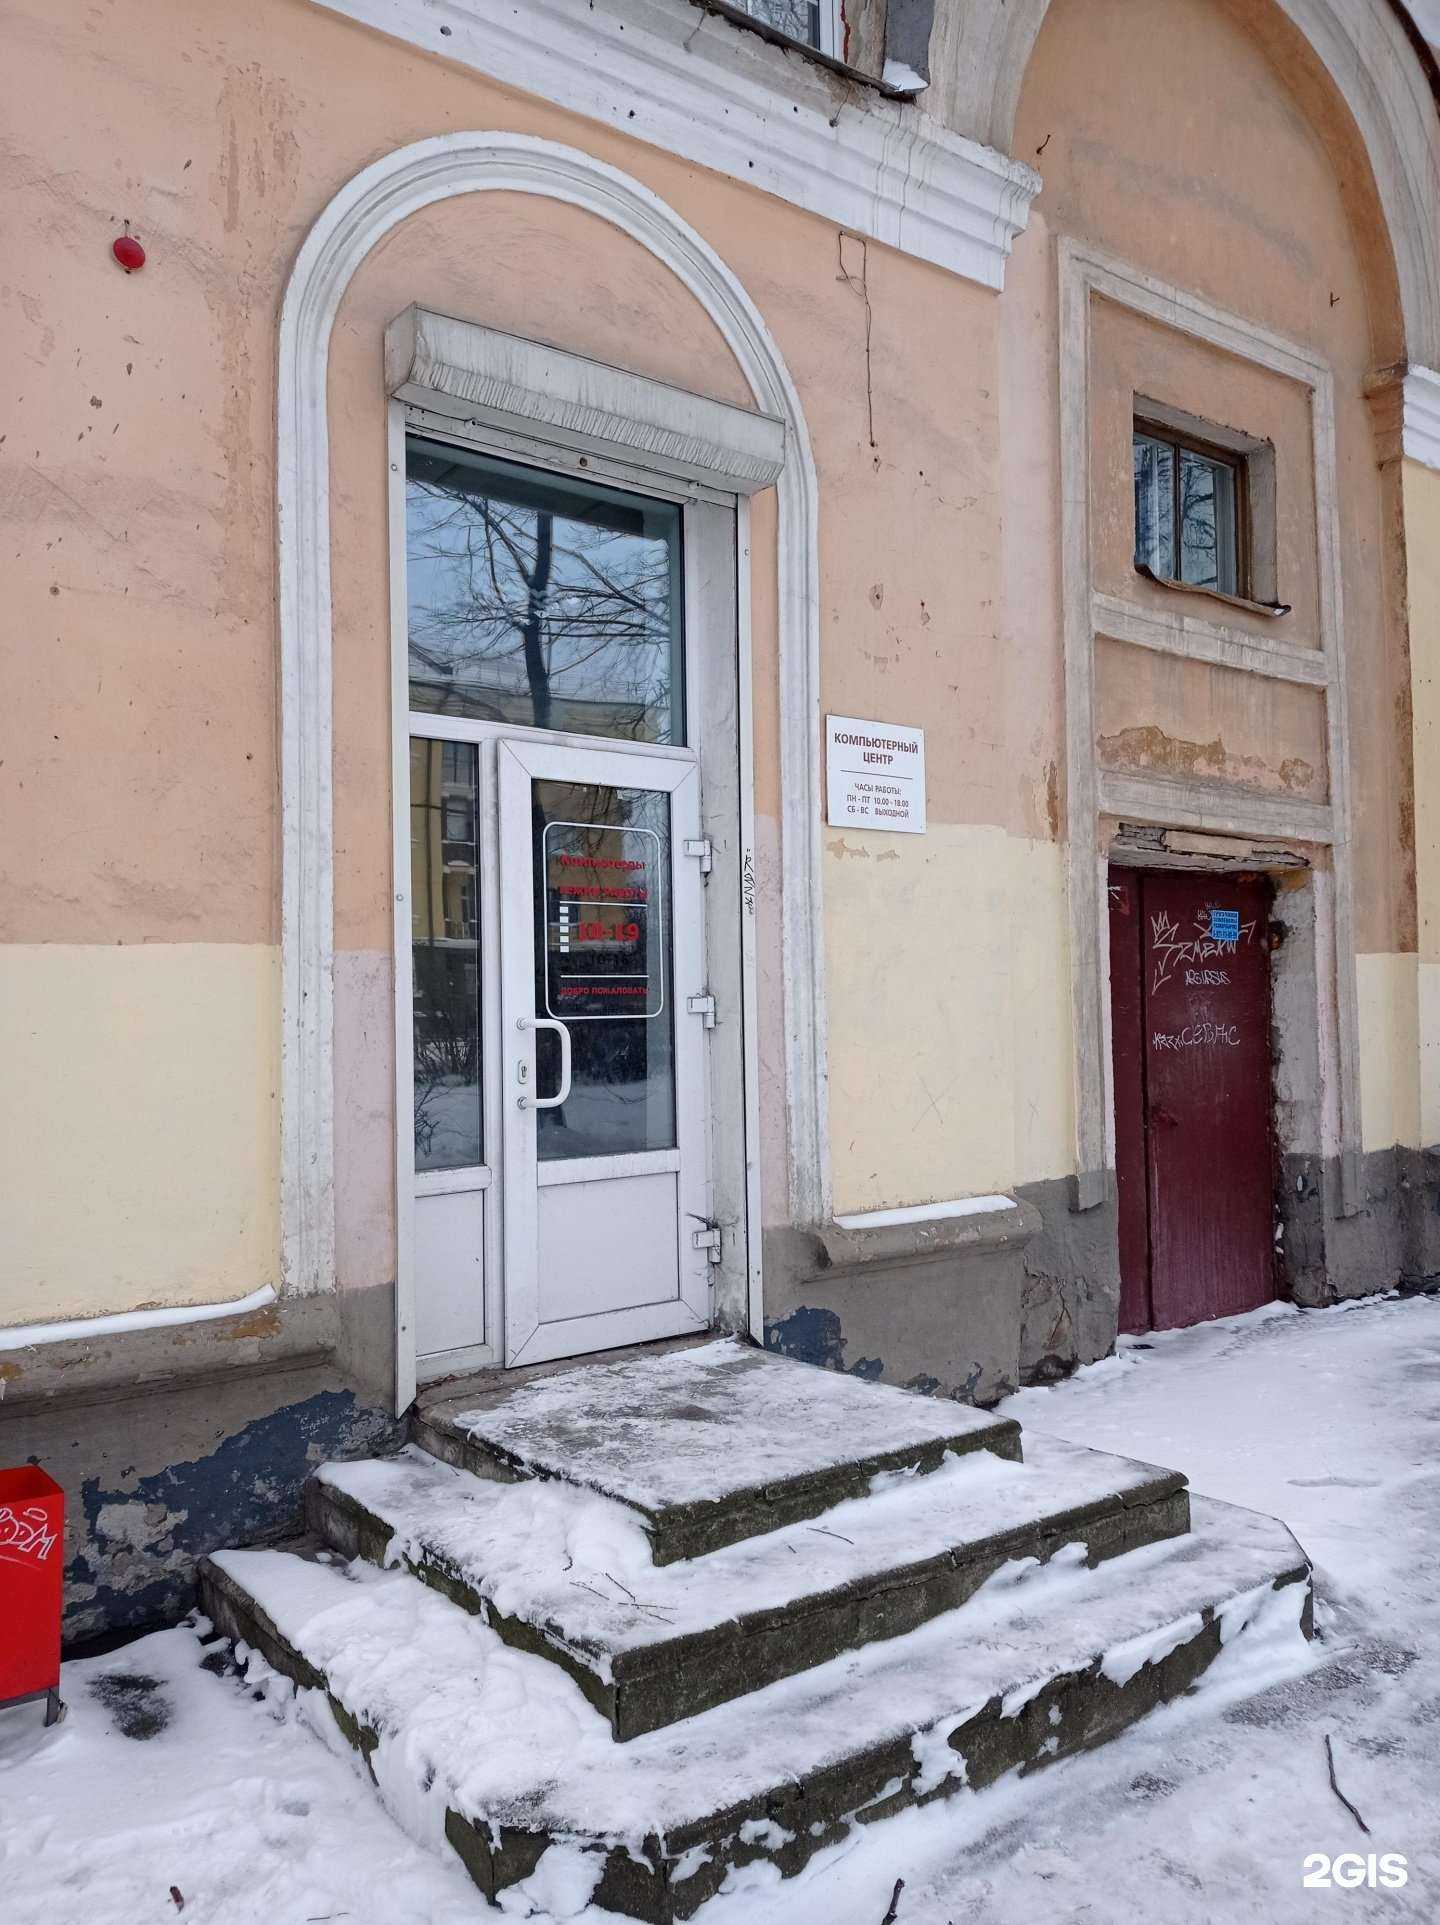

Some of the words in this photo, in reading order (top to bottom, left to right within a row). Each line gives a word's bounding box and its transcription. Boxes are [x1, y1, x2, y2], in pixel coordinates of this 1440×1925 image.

[834, 732, 919, 754] КОМПЬЮТЕРНЫЙ
[863, 752, 894, 765] ЦЕНТР
[854, 783, 873, 792] ЧАСЫ
[875, 785, 902, 795] РАБОТЫ:
[847, 794, 857, 803] ПН
[861, 796, 871, 804] ПТ
[874, 797, 890, 806] 10.00
[847, 805, 856, 813] СБ
[860, 806, 869, 815] ВС
[874, 808, 909, 818] ВЫХОДНОЙ
